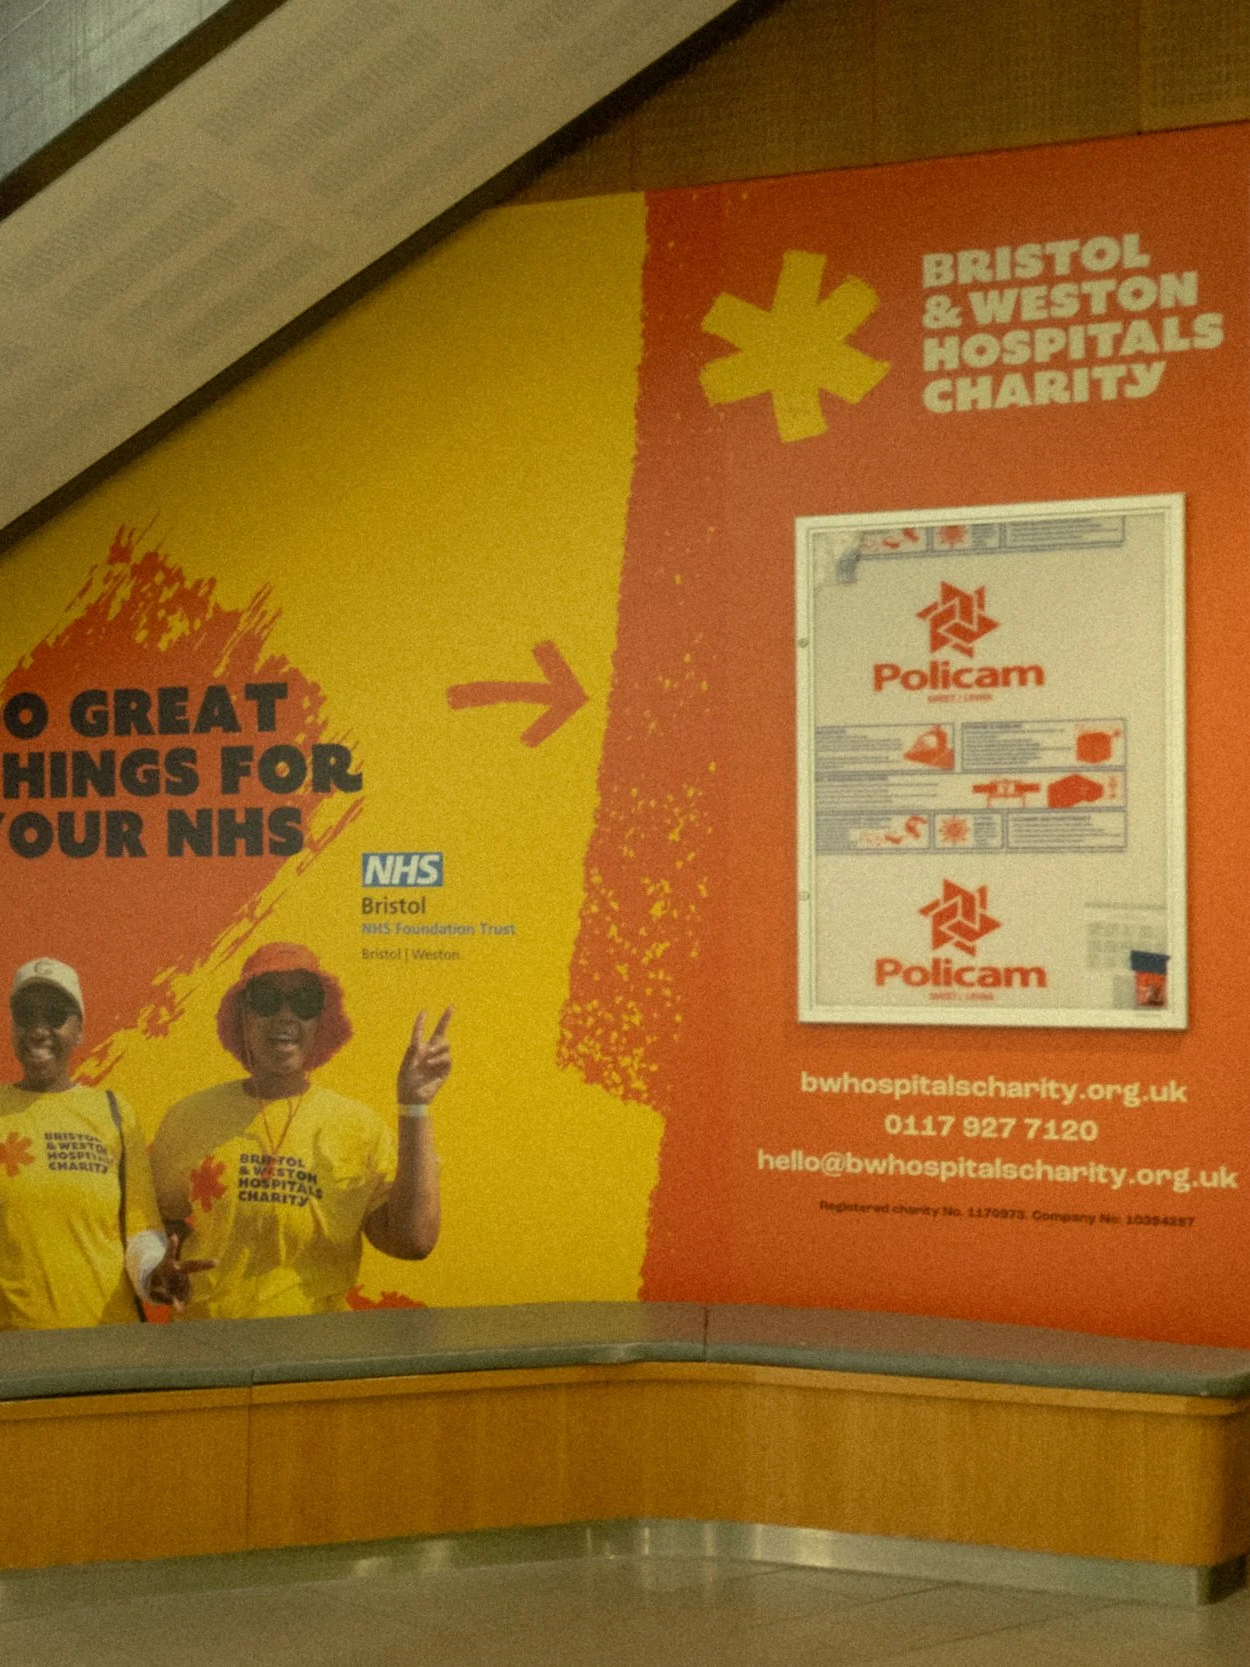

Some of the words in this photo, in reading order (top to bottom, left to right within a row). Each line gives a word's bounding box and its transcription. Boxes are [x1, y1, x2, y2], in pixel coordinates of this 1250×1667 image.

[922, 233, 1149, 288] BRISTOL
[922, 295, 962, 329] &
[968, 271, 1198, 325] WESTON
[923, 313, 1224, 372] HOSPITALS
[923, 361, 1166, 414] CHARITY
[874, 660, 1045, 692] Policam
[69, 682, 288, 737] GREAT
[221, 743, 363, 795] FOR
[167, 806, 304, 857] NHS
[365, 855, 440, 885] NHS
[362, 896, 426, 915] Bristol
[362, 923, 390, 935] NHS
[396, 922, 475, 935] Foundation
[480, 923, 516, 936] Trust
[362, 948, 401, 960] Bristol
[413, 949, 460, 961] Weston
[875, 957, 1047, 987] Policam
[801, 1072, 1187, 1107] bwhospitalscharity.org.uk
[885, 1114, 954, 1137] 0117
[962, 1116, 1016, 1139] 927
[1024, 1118, 1098, 1142] 7120
[254, 1166, 317, 1184] WSTON
[757, 1149, 1238, 1193] hello@bwhospitalscharity.org.uk
[239, 1178, 323, 1200] HOSPITALS
[239, 1190, 308, 1207] CHARITY
[820, 1200, 889, 1213] Registered
[893, 1204, 938, 1217] charity
[1032, 1210, 1096, 1226] Company
